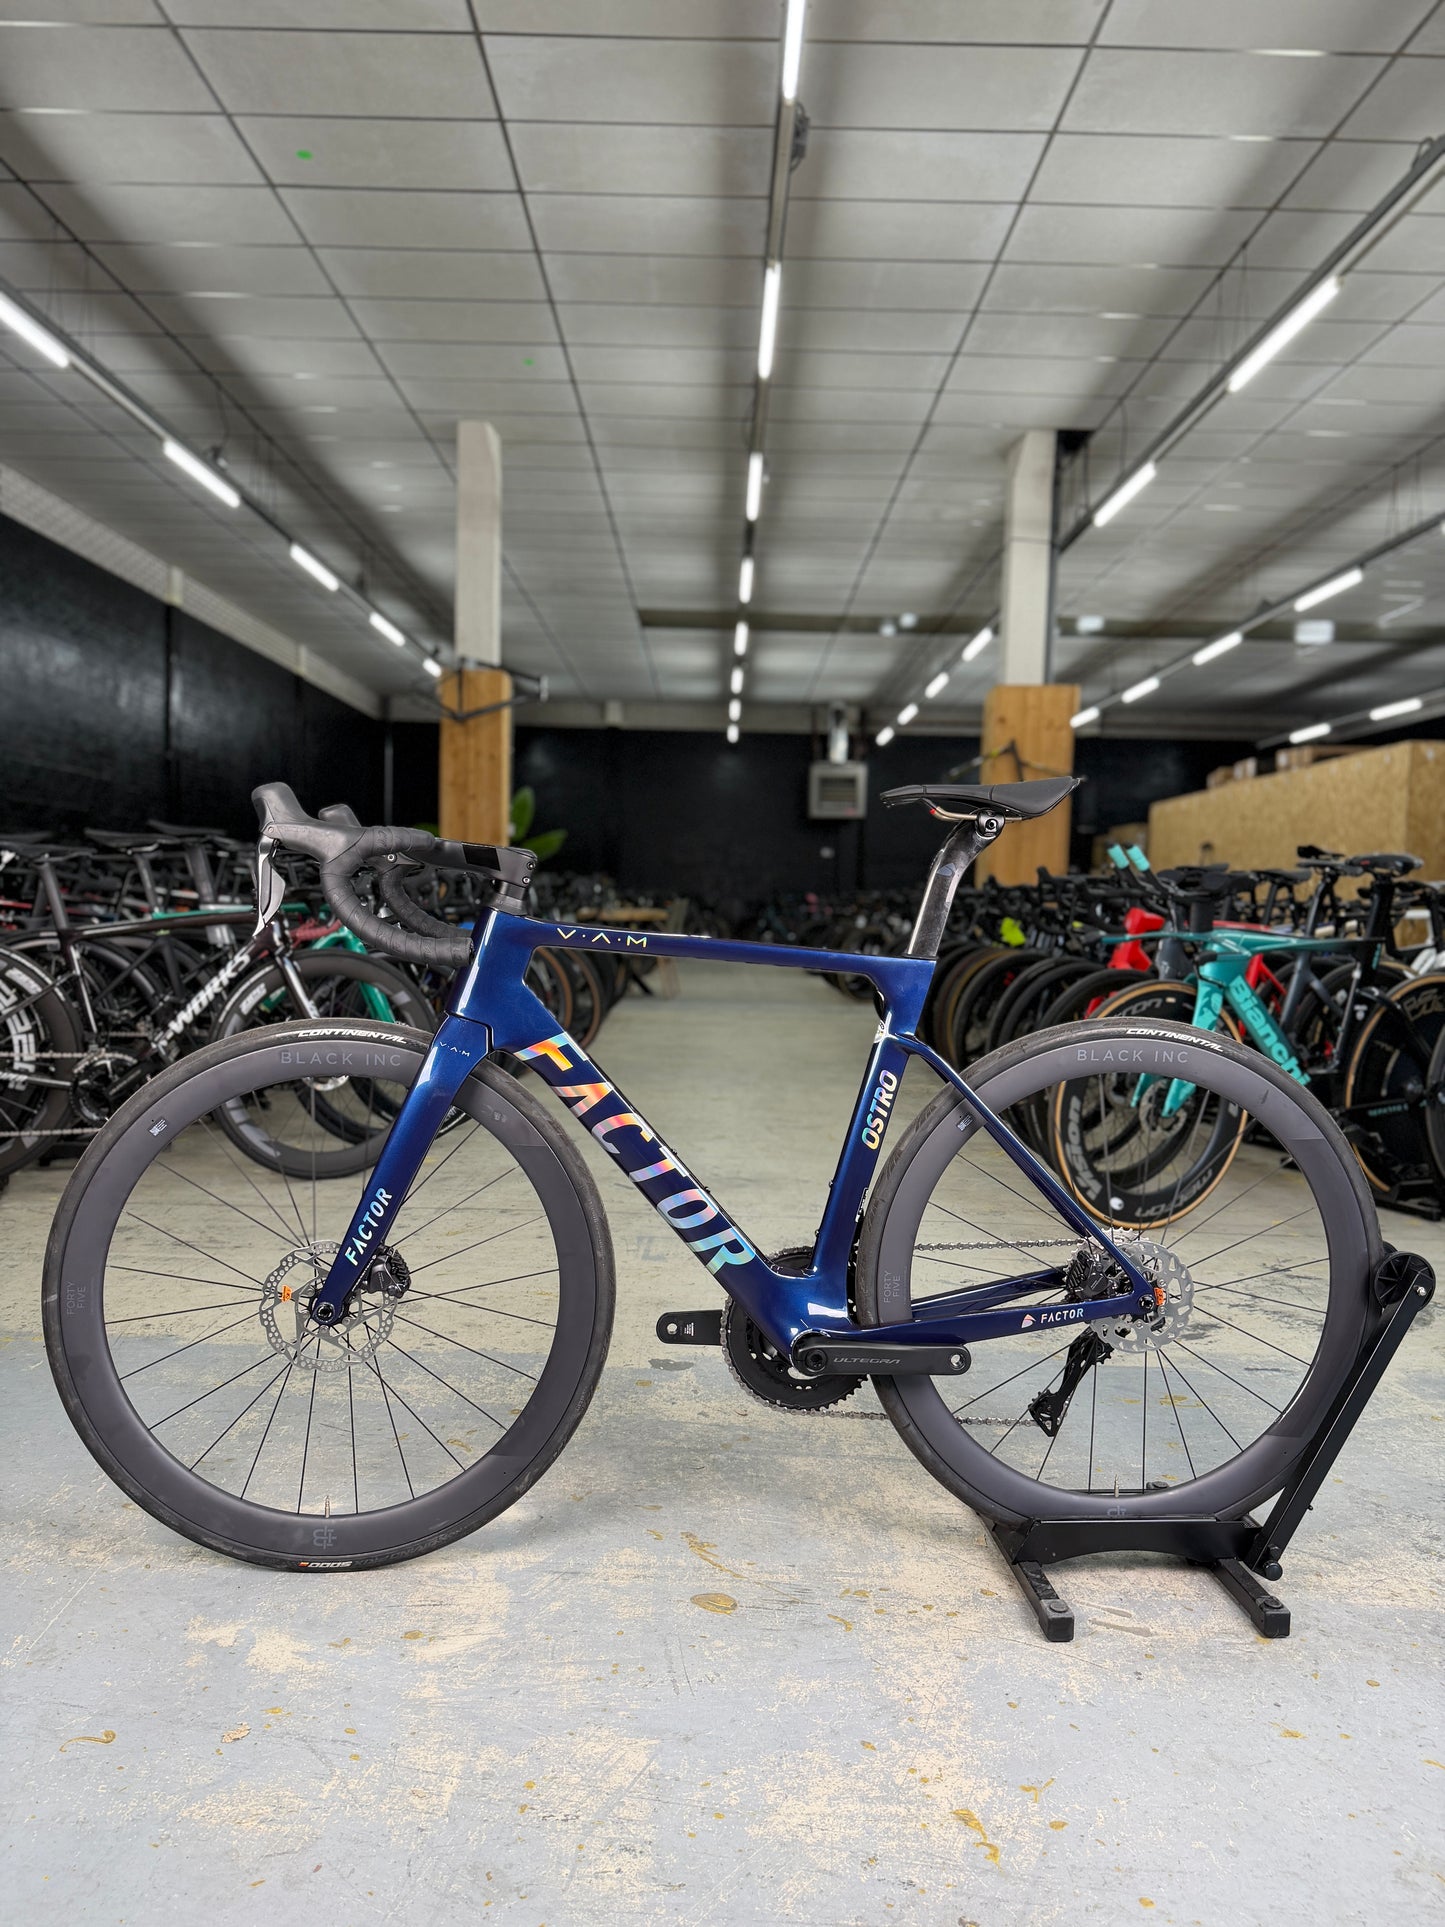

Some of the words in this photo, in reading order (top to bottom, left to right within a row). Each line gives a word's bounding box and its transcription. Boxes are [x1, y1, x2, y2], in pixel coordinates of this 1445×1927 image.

[298, 1028, 407, 1044] CONTINENTAL
[1126, 1028, 1224, 1052] CONTINENTAL
[1228, 975, 1311, 1086] Bianchi
[280, 1051, 353, 1065] BLACK
[366, 1053, 401, 1067] INC
[1077, 1049, 1143, 1062] BLACK
[1154, 1050, 1188, 1063] INC
[861, 1069, 898, 1150] OSTRO
[514, 1031, 756, 1275] FACTOR
[344, 1187, 393, 1267] FACTOR
[66, 1281, 76, 1315] FORTY
[77, 1286, 86, 1308] FIVE
[883, 1270, 892, 1303] FORTY
[893, 1275, 901, 1297] FIVE
[1040, 1307, 1085, 1324] FACTOR
